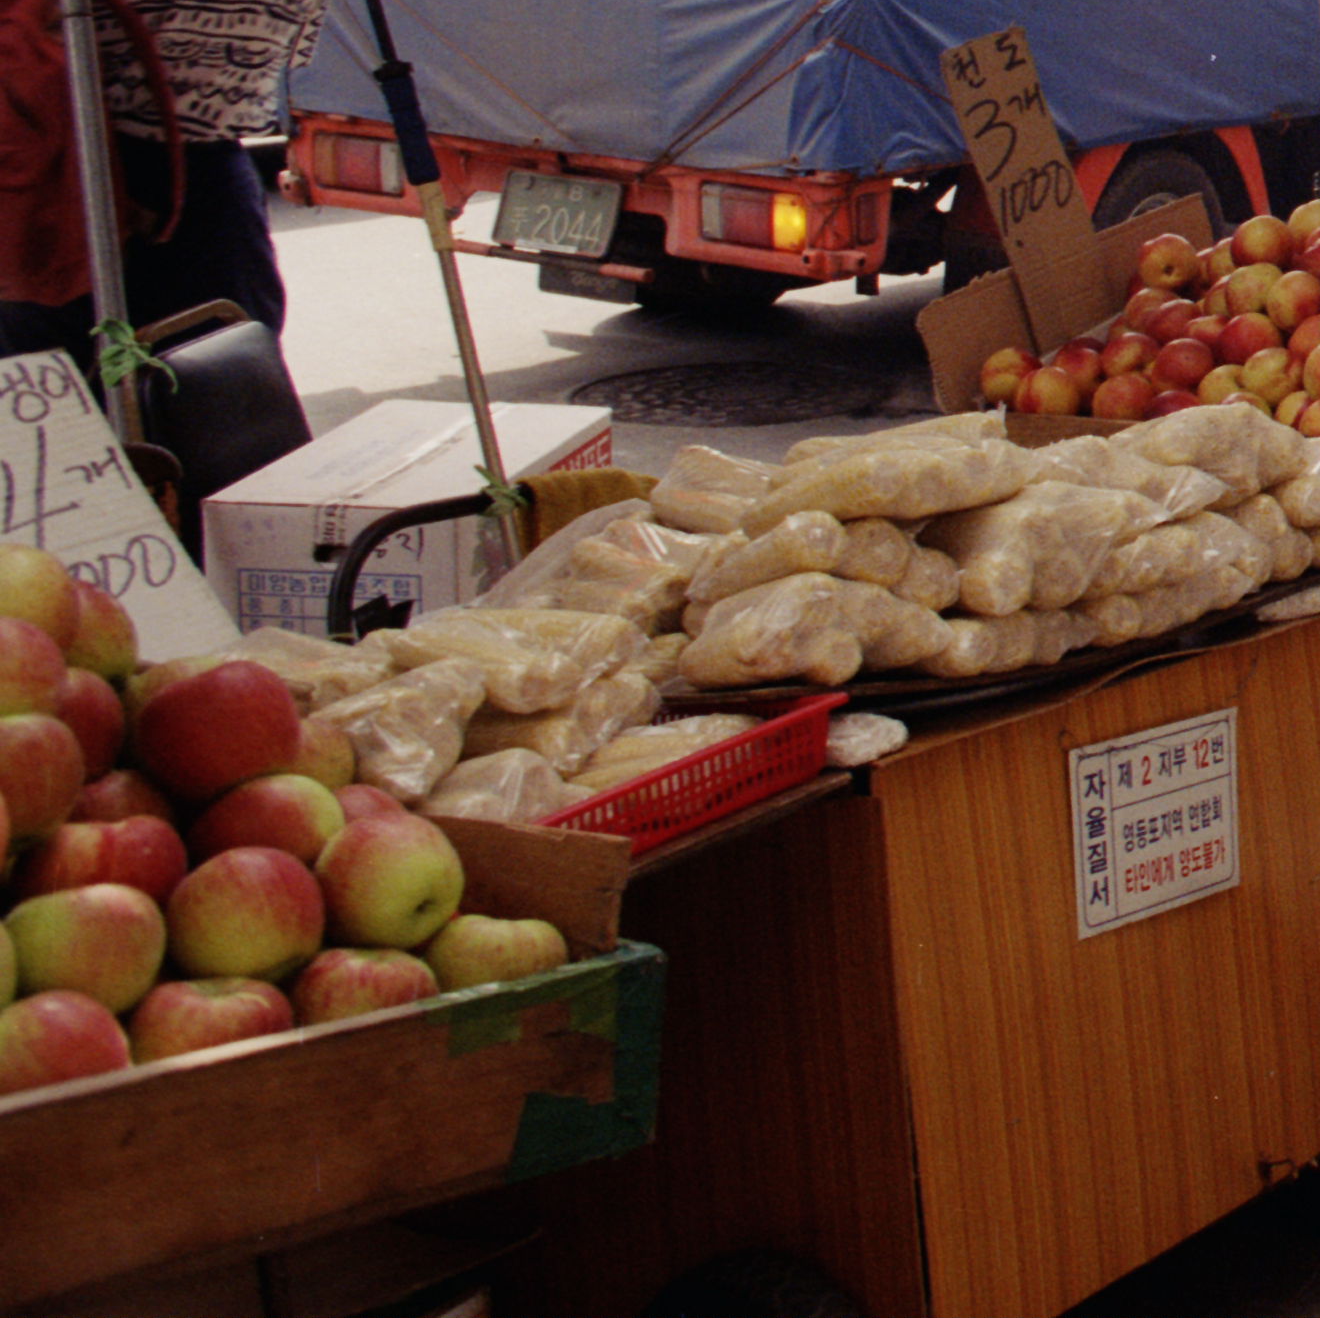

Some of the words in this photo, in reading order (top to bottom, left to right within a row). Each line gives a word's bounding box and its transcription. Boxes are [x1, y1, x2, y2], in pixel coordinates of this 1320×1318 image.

[531, 203, 604, 249] 2044
[1117, 759, 1134, 789] 제
[1141, 755, 1153, 786] 2
